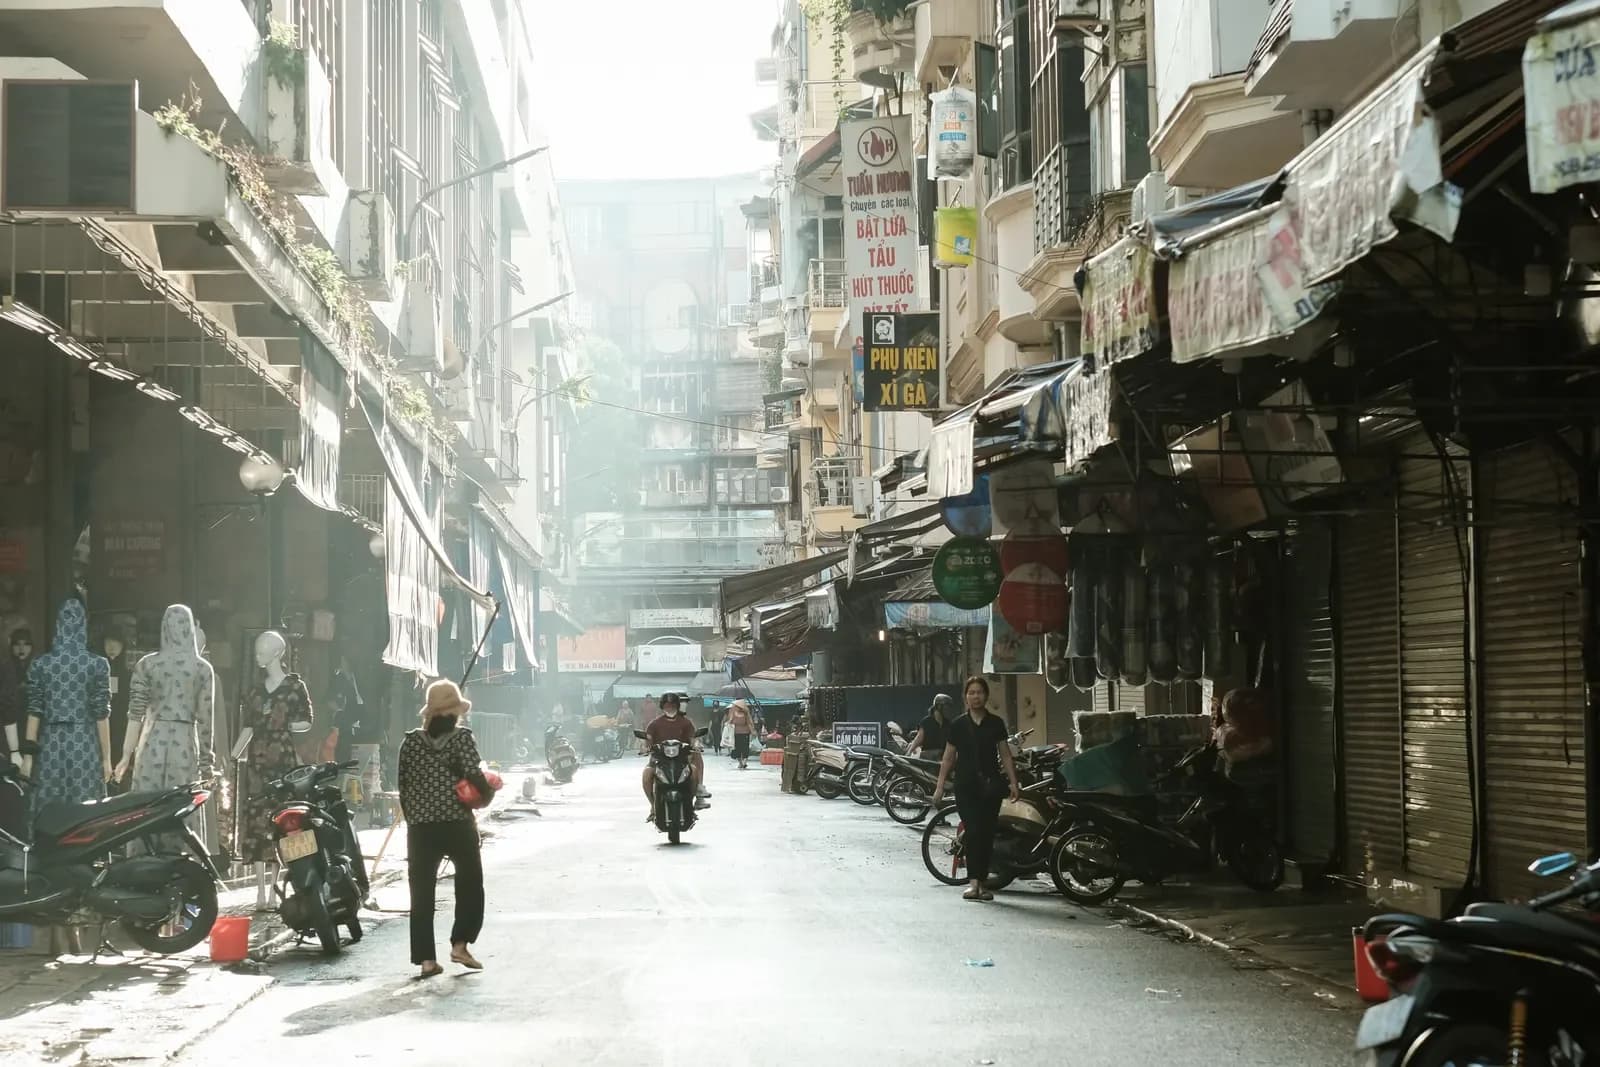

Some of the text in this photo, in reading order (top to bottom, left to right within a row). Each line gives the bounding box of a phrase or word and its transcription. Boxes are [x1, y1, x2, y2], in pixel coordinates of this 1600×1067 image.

[862, 138, 894, 155] T H
[847, 169, 874, 197] TUẤN
[850, 196, 910, 212] Chuyên các loại
[857, 209, 907, 242] BẬT LỬA
[868, 238, 896, 268] TẨU
[852, 268, 914, 298] HÚT THUỐC
[870, 343, 937, 375] PHỤ KIỆN
[880, 378, 927, 406] XÌ GÀ
[836, 731, 851, 745] CẤM
[862, 733, 876, 745] RÁC
